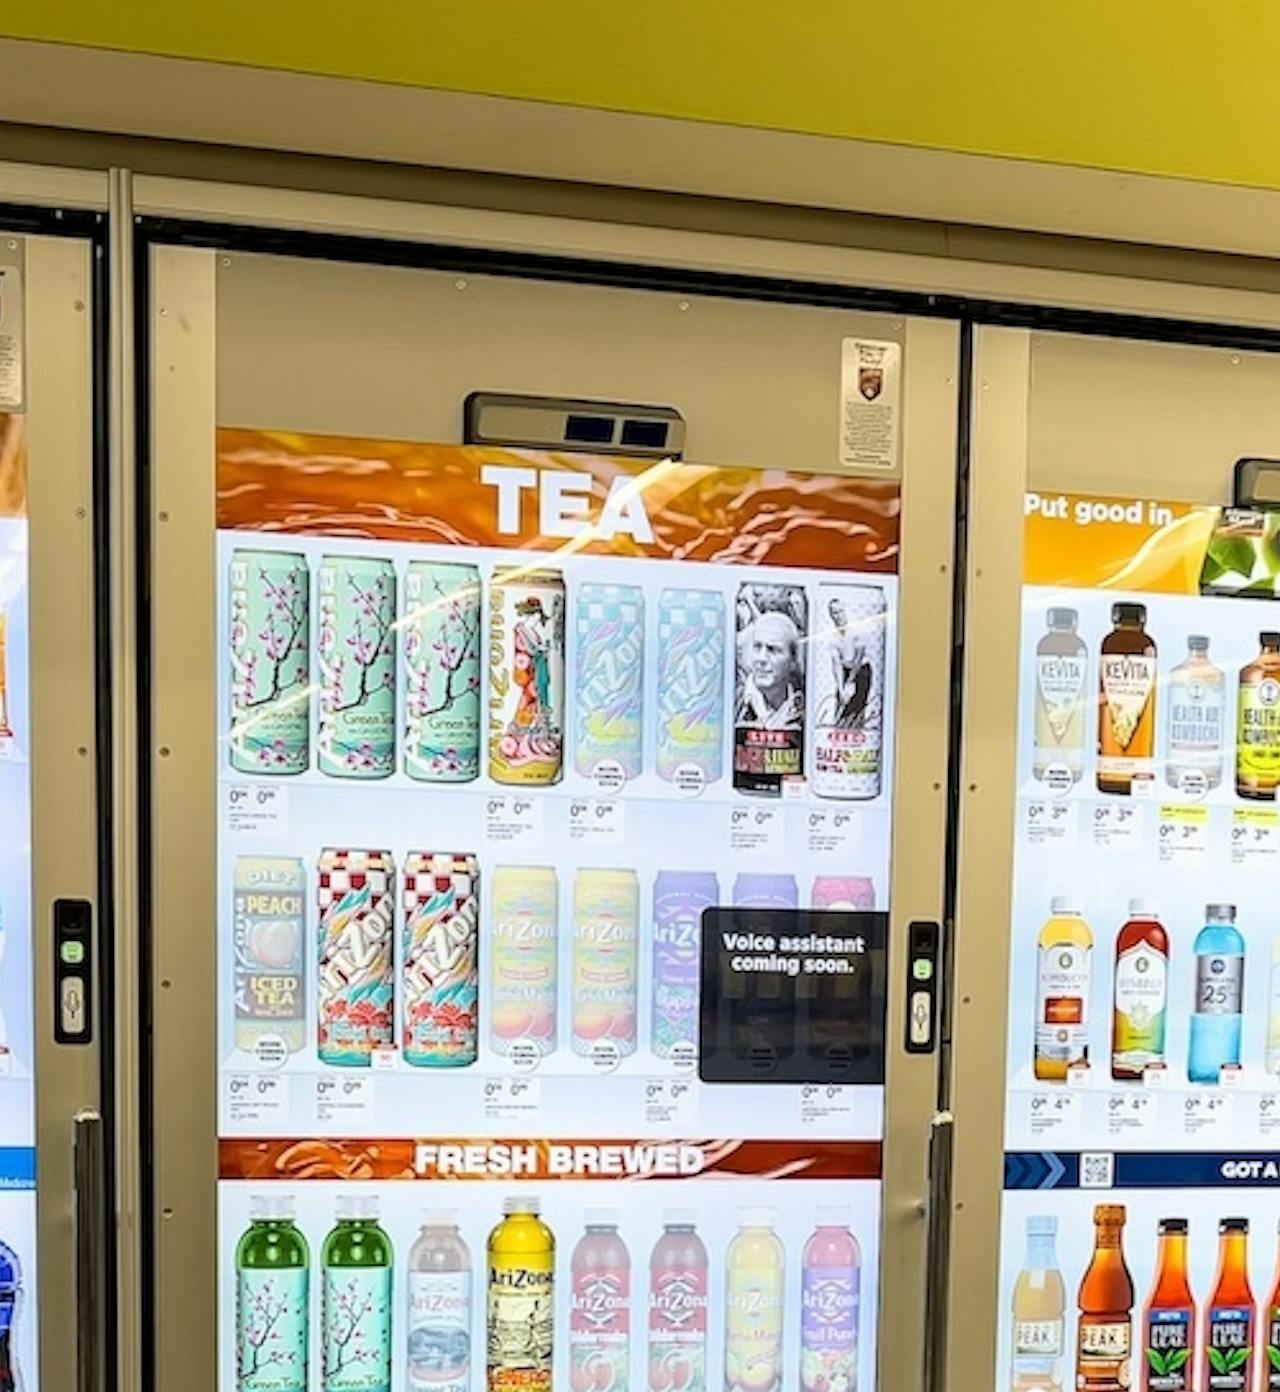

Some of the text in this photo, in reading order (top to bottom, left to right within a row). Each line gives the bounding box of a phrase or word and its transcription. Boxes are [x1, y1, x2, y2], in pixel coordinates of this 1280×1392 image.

[481, 464, 656, 544] TEA
[1024, 492, 1068, 518] Put
[1075, 501, 1143, 525] good
[246, 896, 301, 914] PEACH
[723, 932, 865, 954] Voice assistant
[731, 955, 854, 976] coming soon.
[250, 977, 298, 992] ICED
[257, 991, 294, 1005] TEA
[416, 1145, 707, 1175] FRESH BREWED
[1221, 1162, 1262, 1178] GOT
[1264, 1162, 1278, 1178] A
